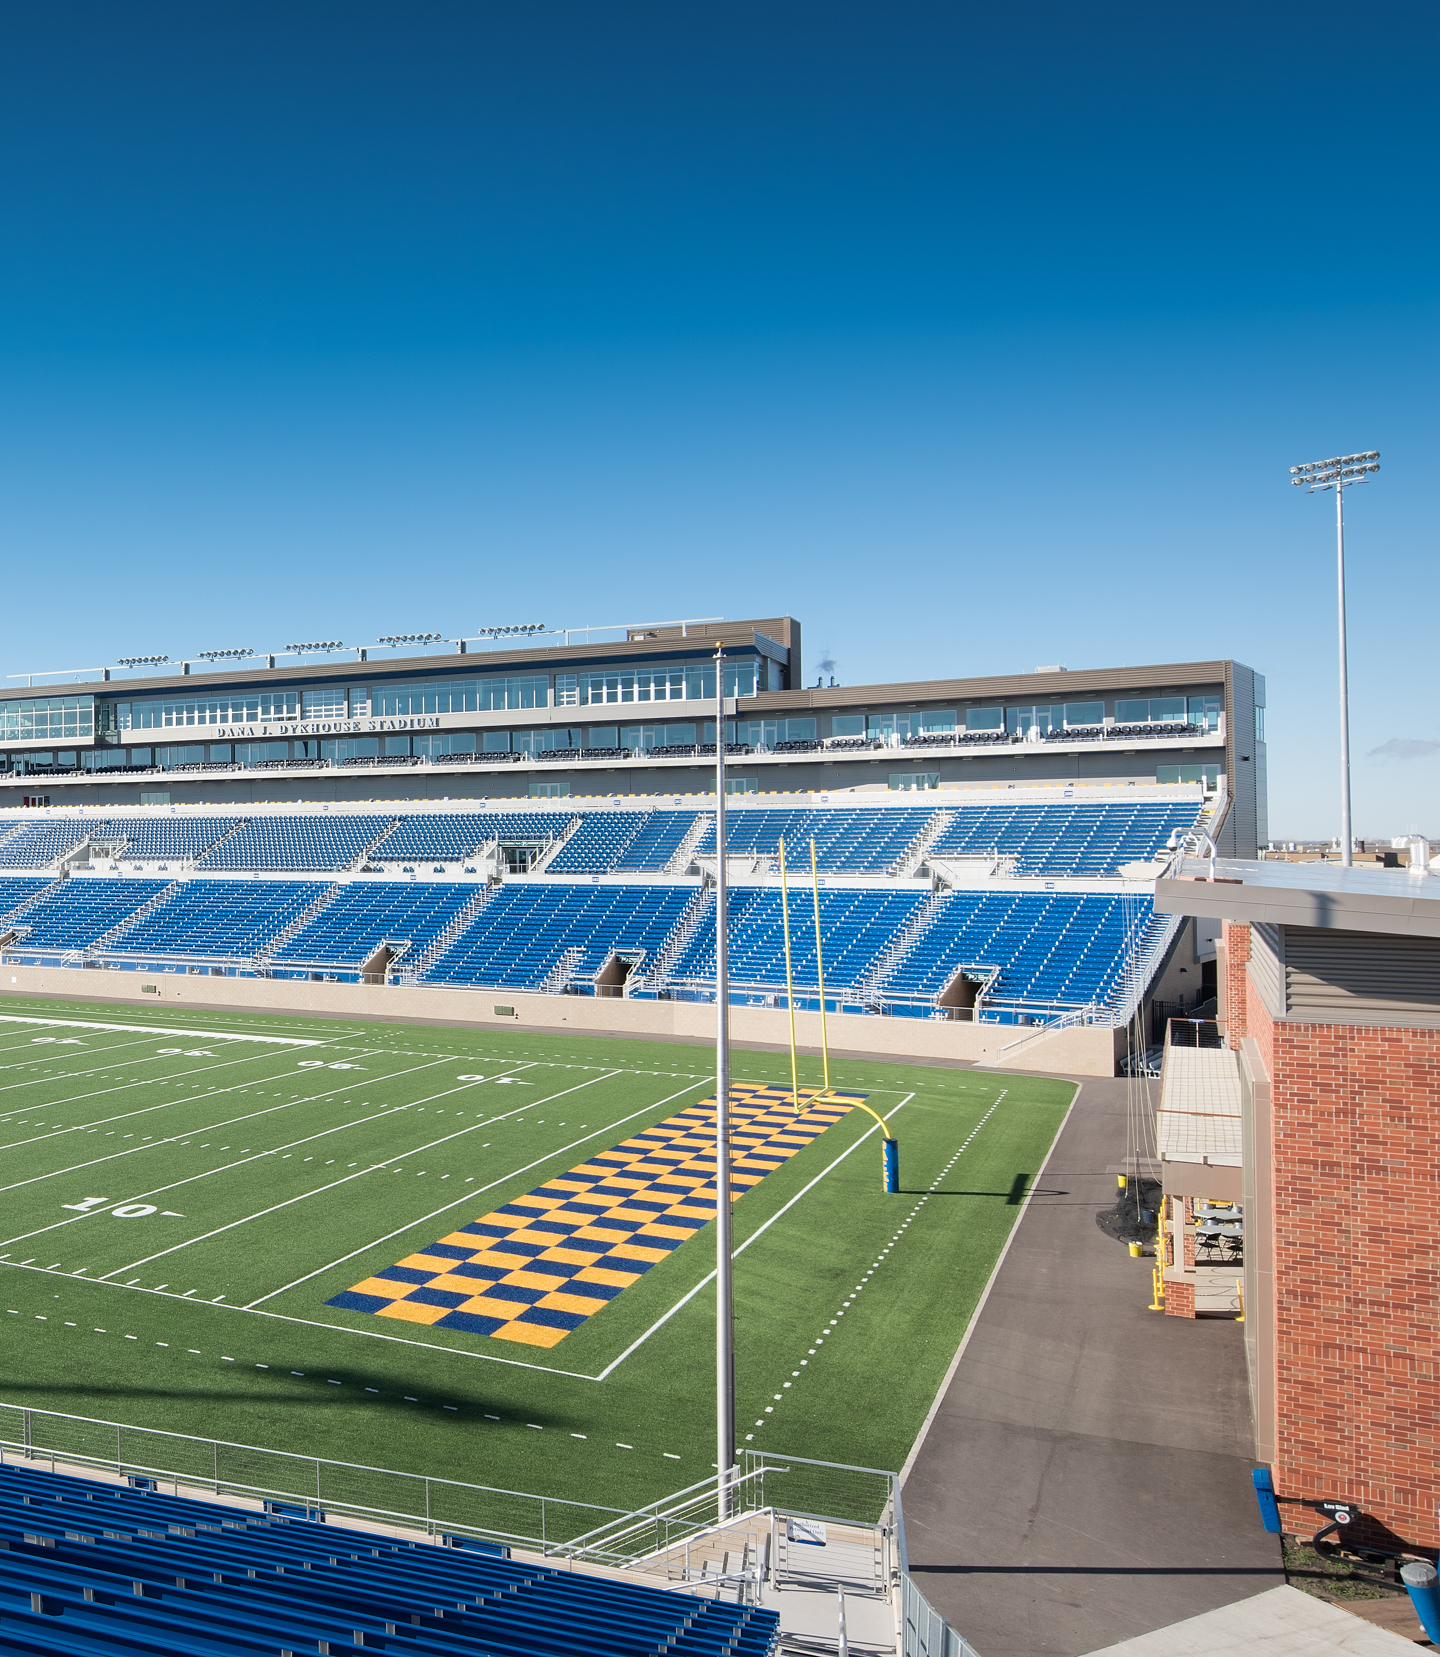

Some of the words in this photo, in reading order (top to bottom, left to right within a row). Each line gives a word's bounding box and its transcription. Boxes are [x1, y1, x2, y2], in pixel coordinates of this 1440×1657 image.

[217, 726, 255, 738] DANA
[261, 725, 273, 736] J.
[278, 721, 361, 735] DYKHOUSE
[368, 717, 441, 731] STADIUM
[61, 1197, 157, 1218] 10
